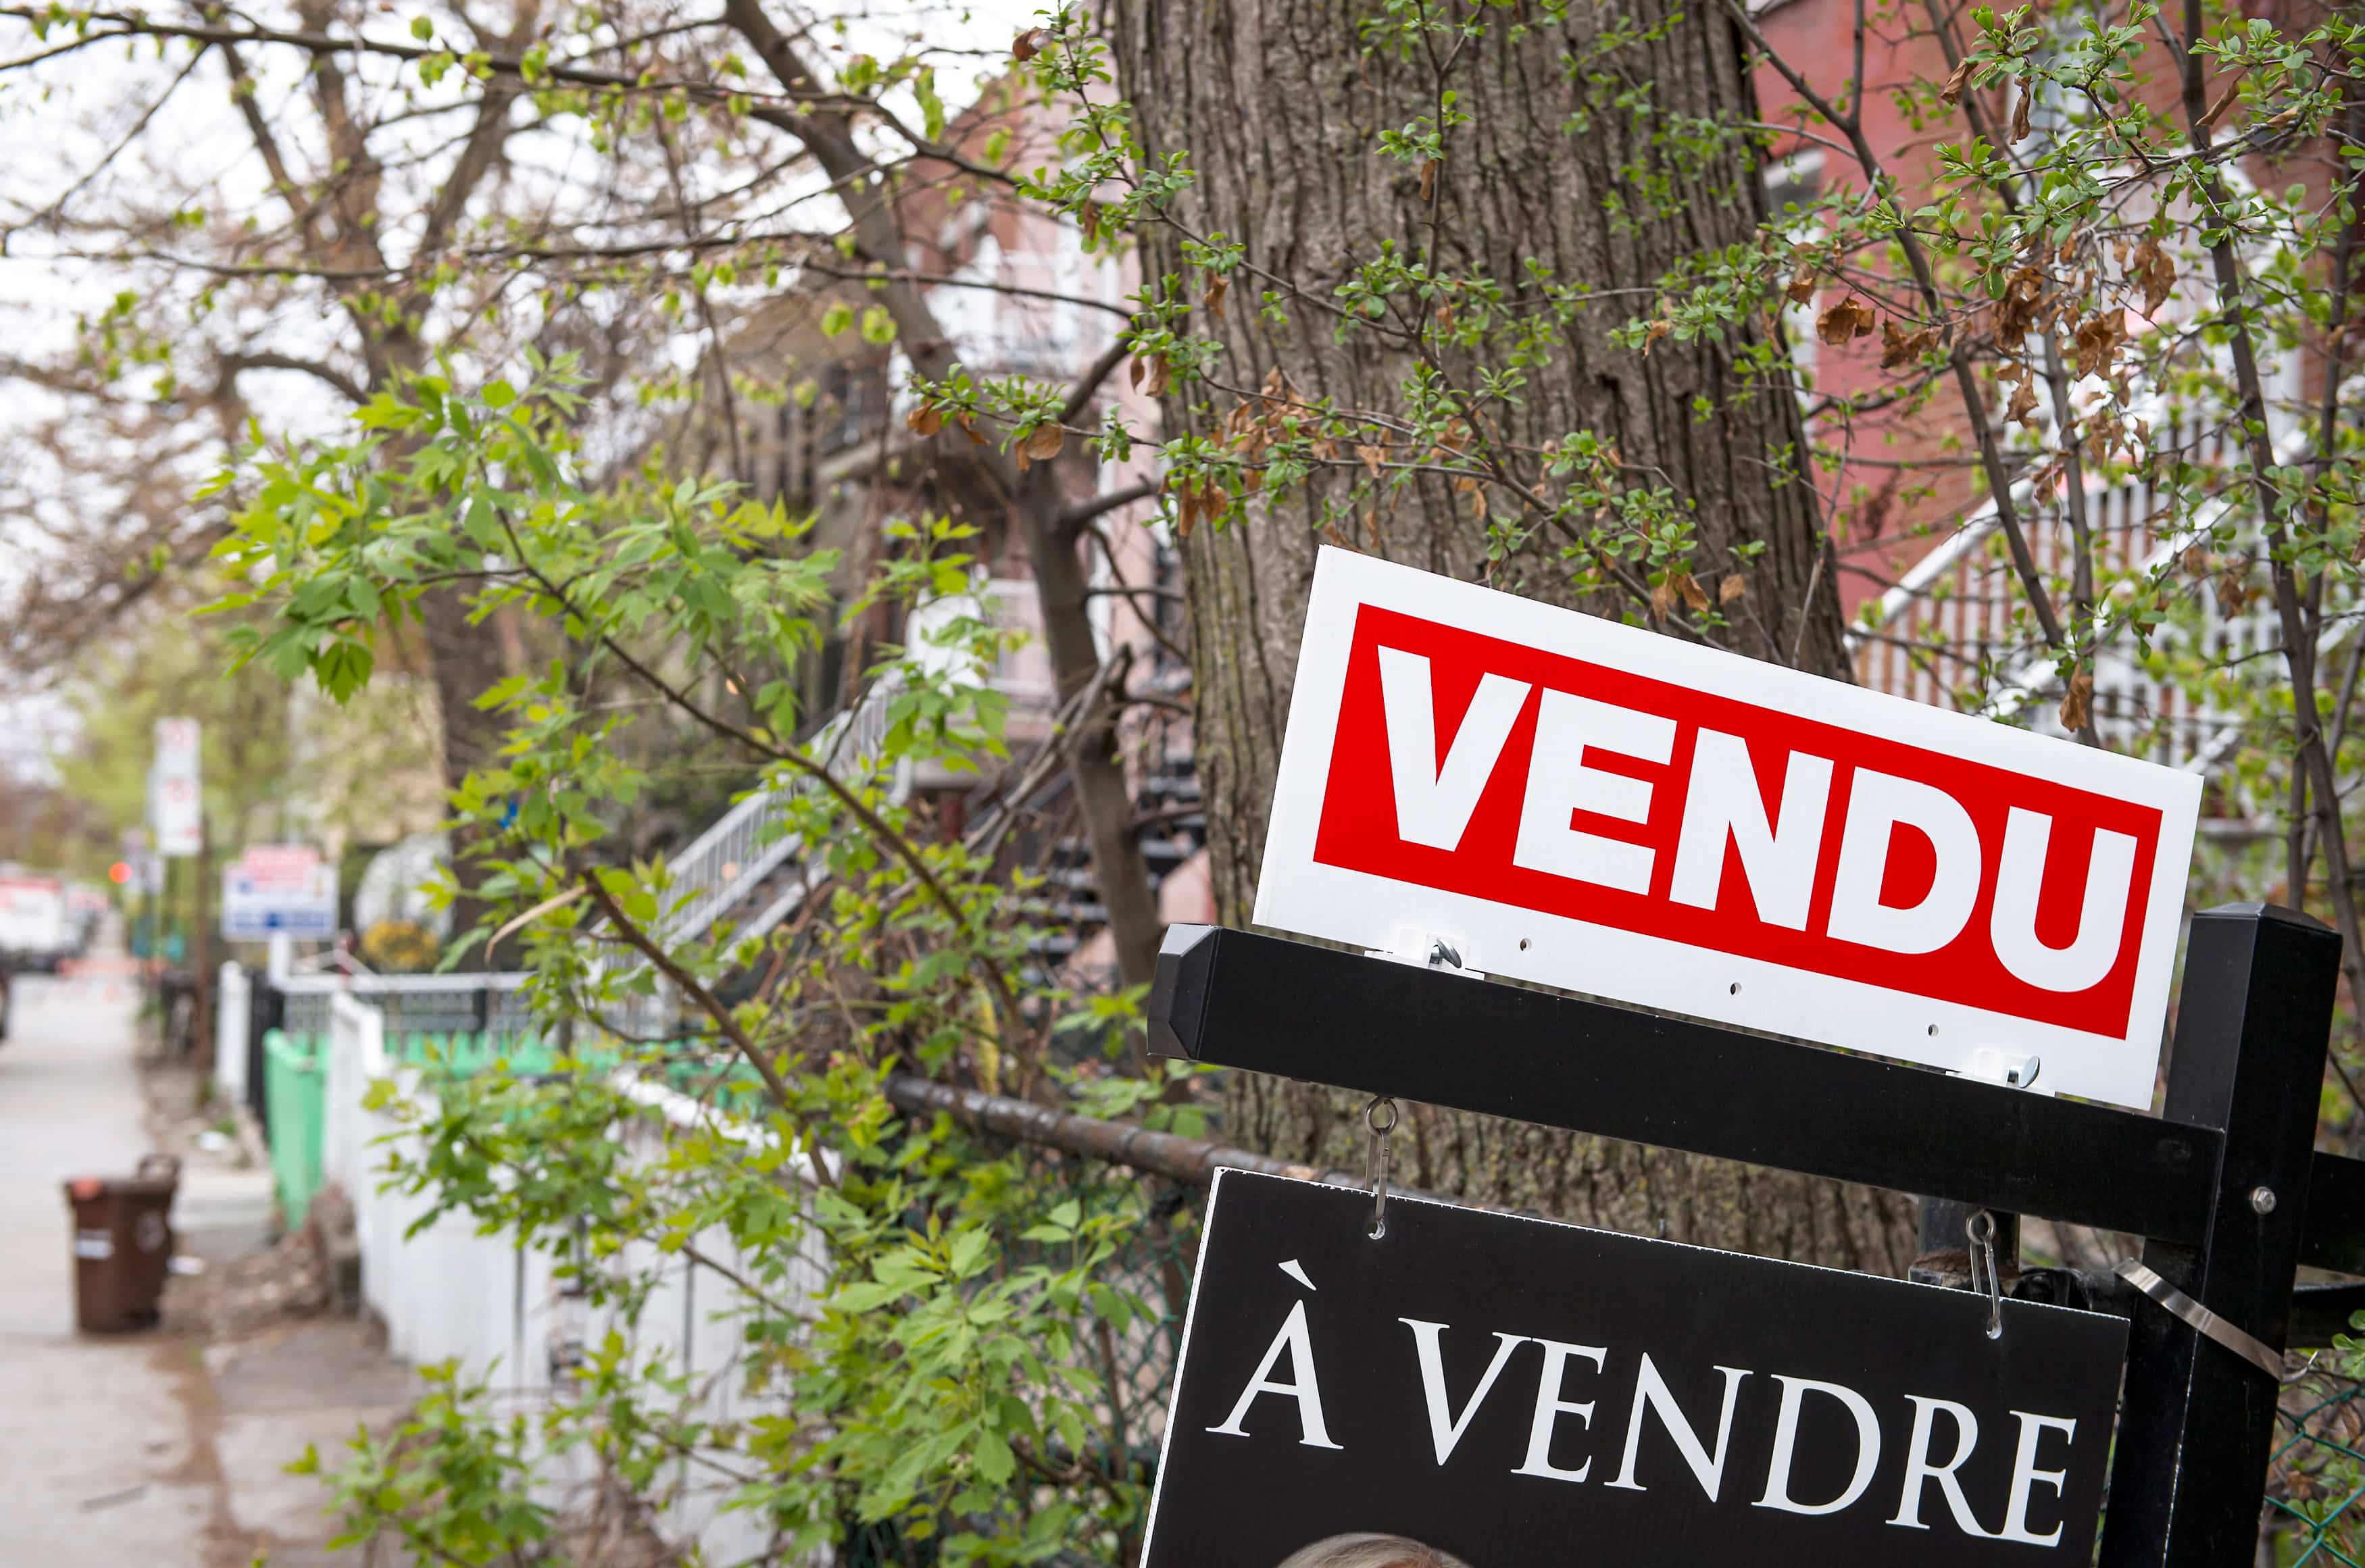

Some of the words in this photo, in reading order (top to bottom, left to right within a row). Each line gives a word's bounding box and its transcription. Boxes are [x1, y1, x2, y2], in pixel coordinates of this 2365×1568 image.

[1376, 644, 2139, 993] VENDU
[1205, 1259, 1345, 1450] À
[1397, 1317, 2078, 1548] VENDRE
